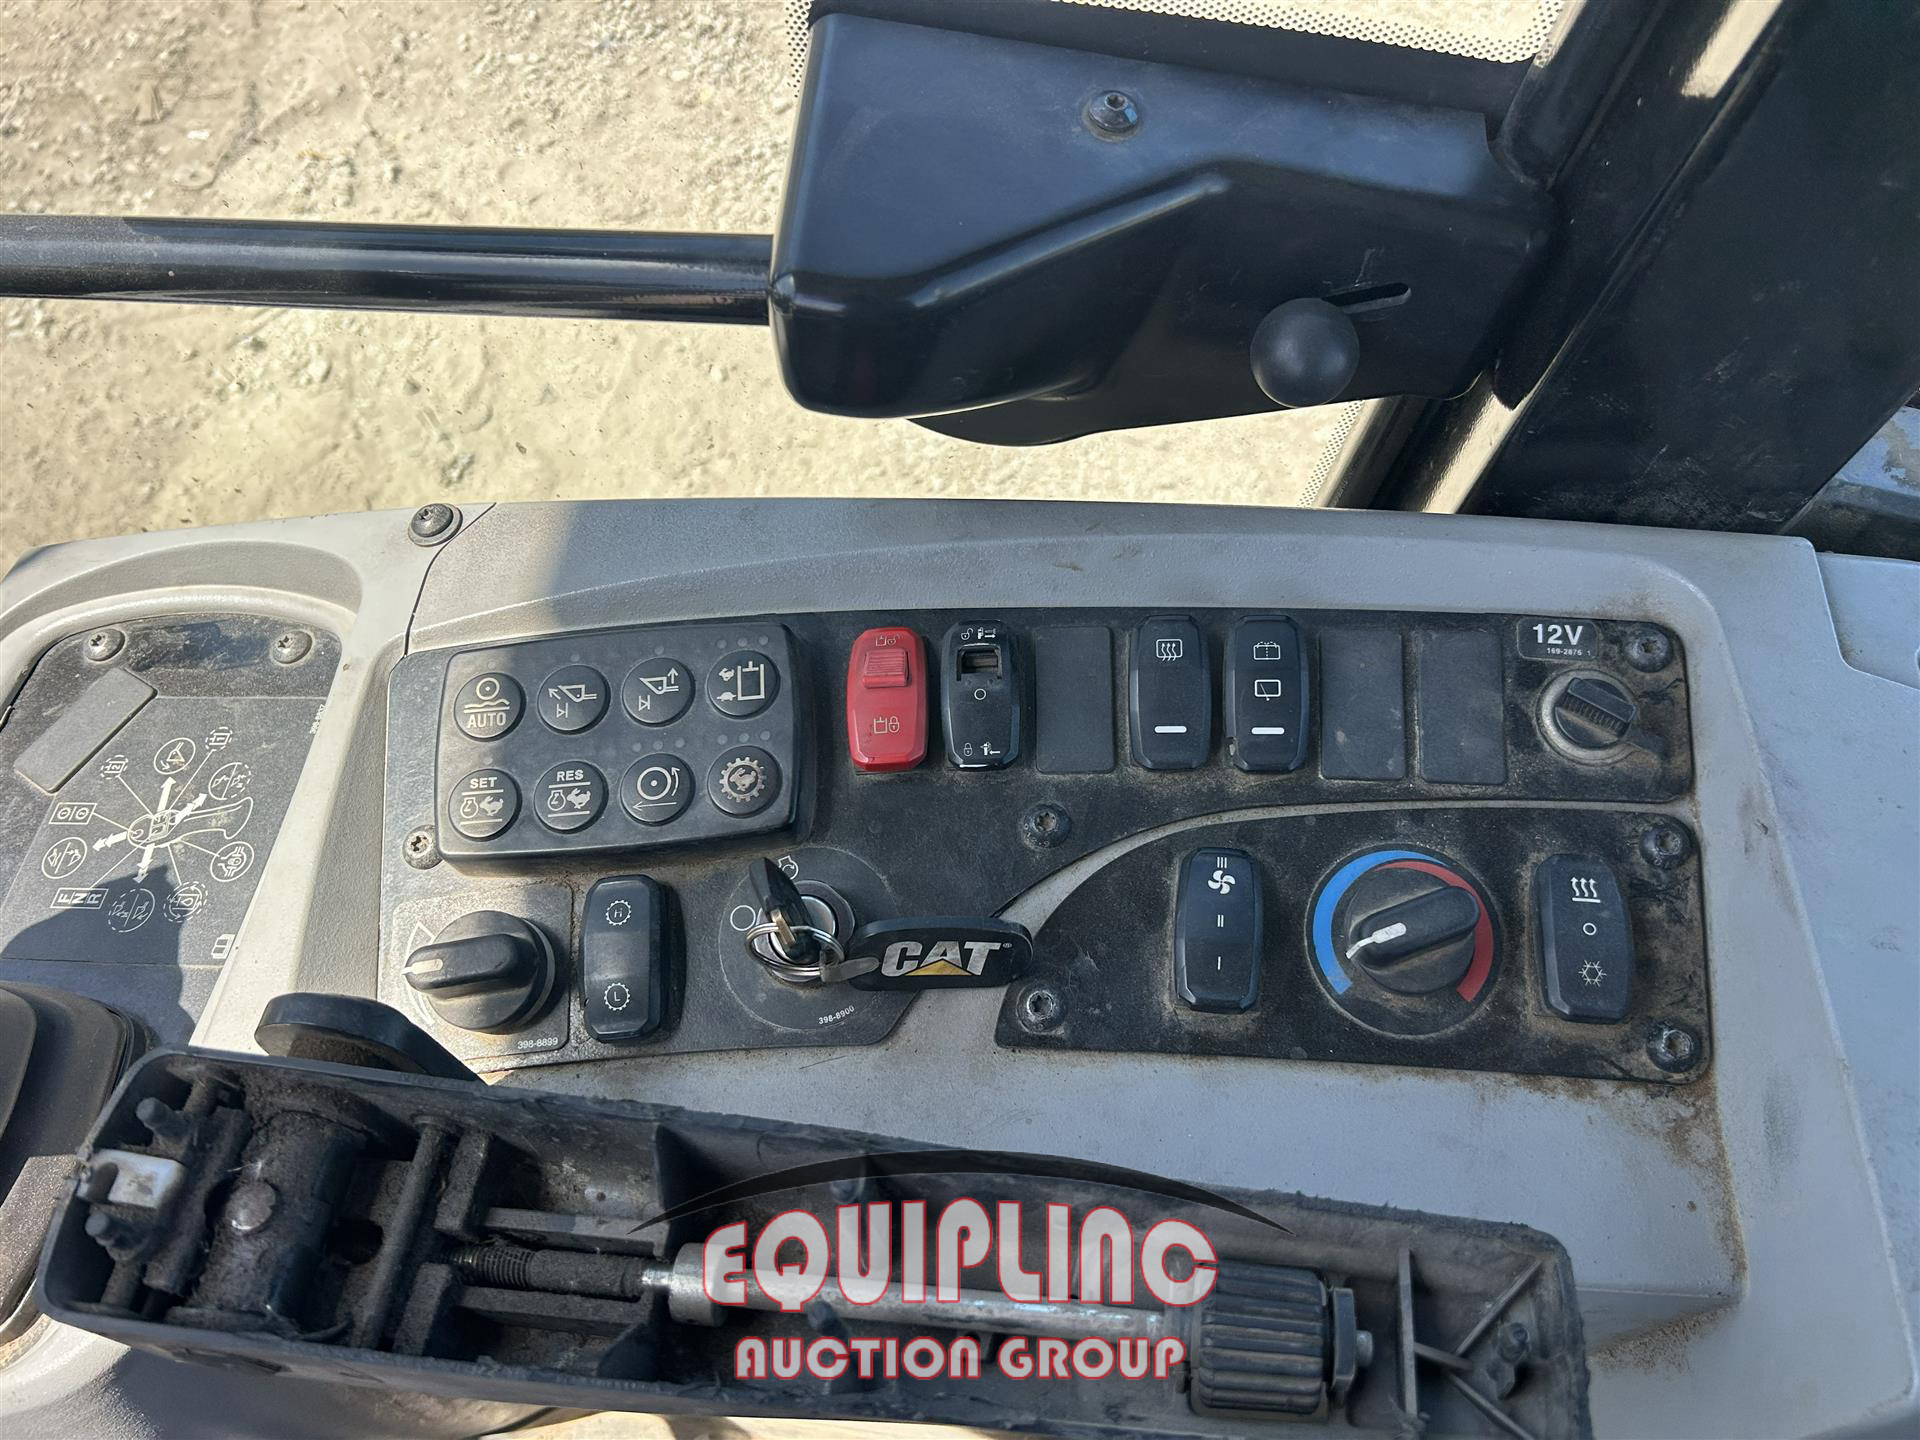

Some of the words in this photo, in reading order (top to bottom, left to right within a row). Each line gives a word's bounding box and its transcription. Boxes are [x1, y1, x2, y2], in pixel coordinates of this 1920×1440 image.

[1532, 623, 1584, 646] 12V
[467, 713, 507, 730] AUTO
[469, 776, 498, 789] SET
[556, 769, 585, 782] RES
[881, 940, 1002, 977] CAT
[818, 1004, 855, 1025] 398-8900
[517, 1036, 559, 1050] 398-8899
